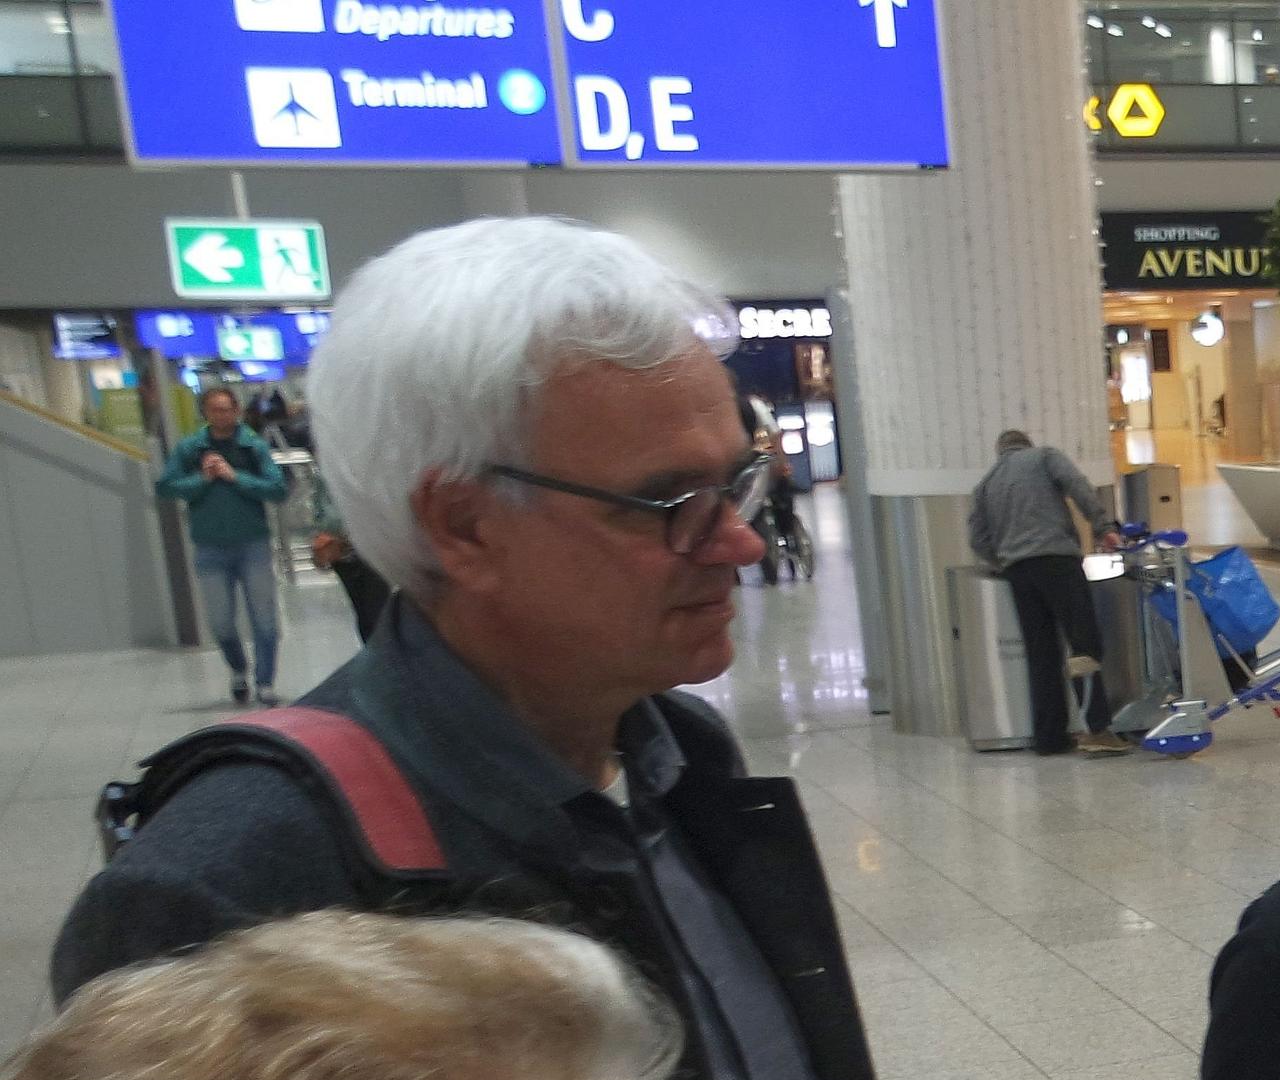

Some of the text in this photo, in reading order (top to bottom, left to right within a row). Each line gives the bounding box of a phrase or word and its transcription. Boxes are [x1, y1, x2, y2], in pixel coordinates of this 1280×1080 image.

[335, 0, 514, 41] Departures
[340, 69, 488, 108] Terminal
[1134, 225, 1220, 242] SHOPPING
[1138, 247, 1271, 278] AVENU
[739, 307, 832, 338] SECRE
